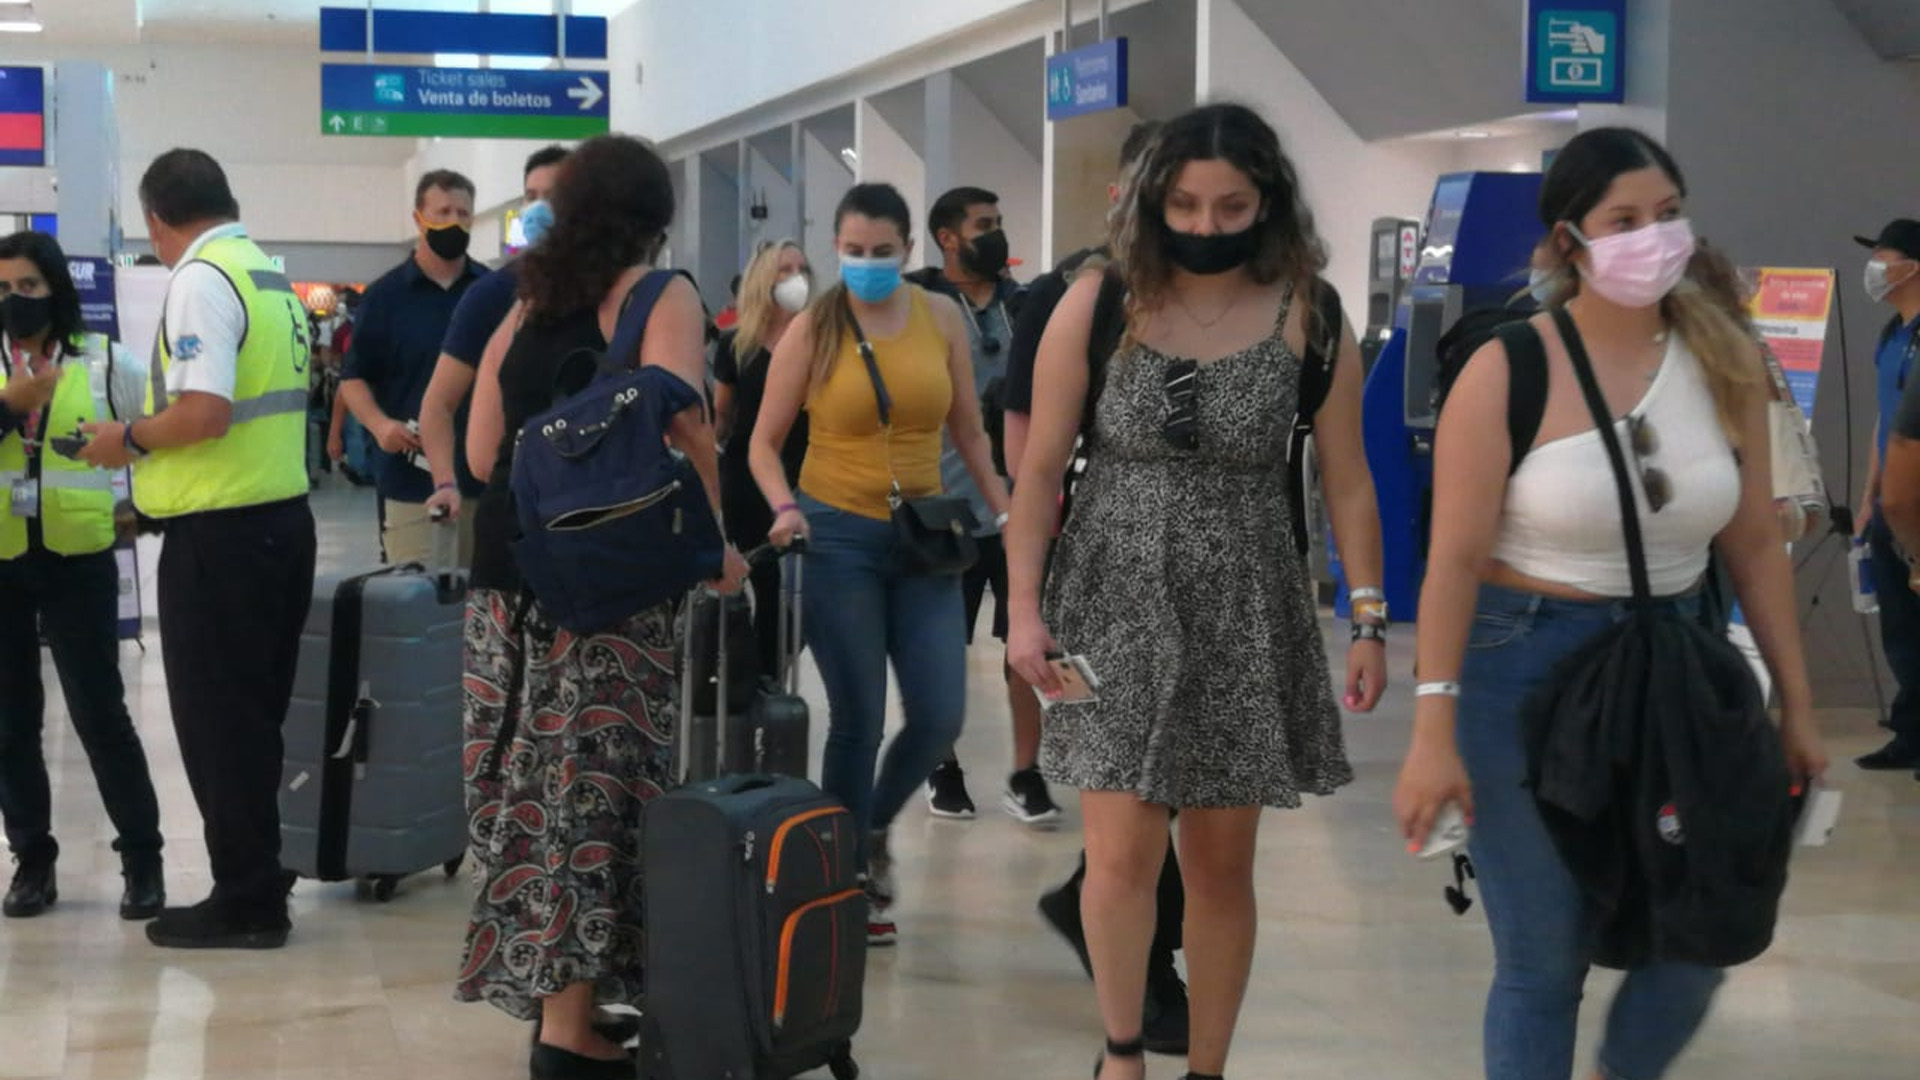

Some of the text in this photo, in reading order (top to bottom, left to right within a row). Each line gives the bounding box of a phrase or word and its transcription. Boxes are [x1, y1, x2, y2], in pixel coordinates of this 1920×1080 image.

[418, 69, 506, 88] Ticket sales
[417, 87, 552, 108] Venta de boletos
[353, 115, 362, 131] E
